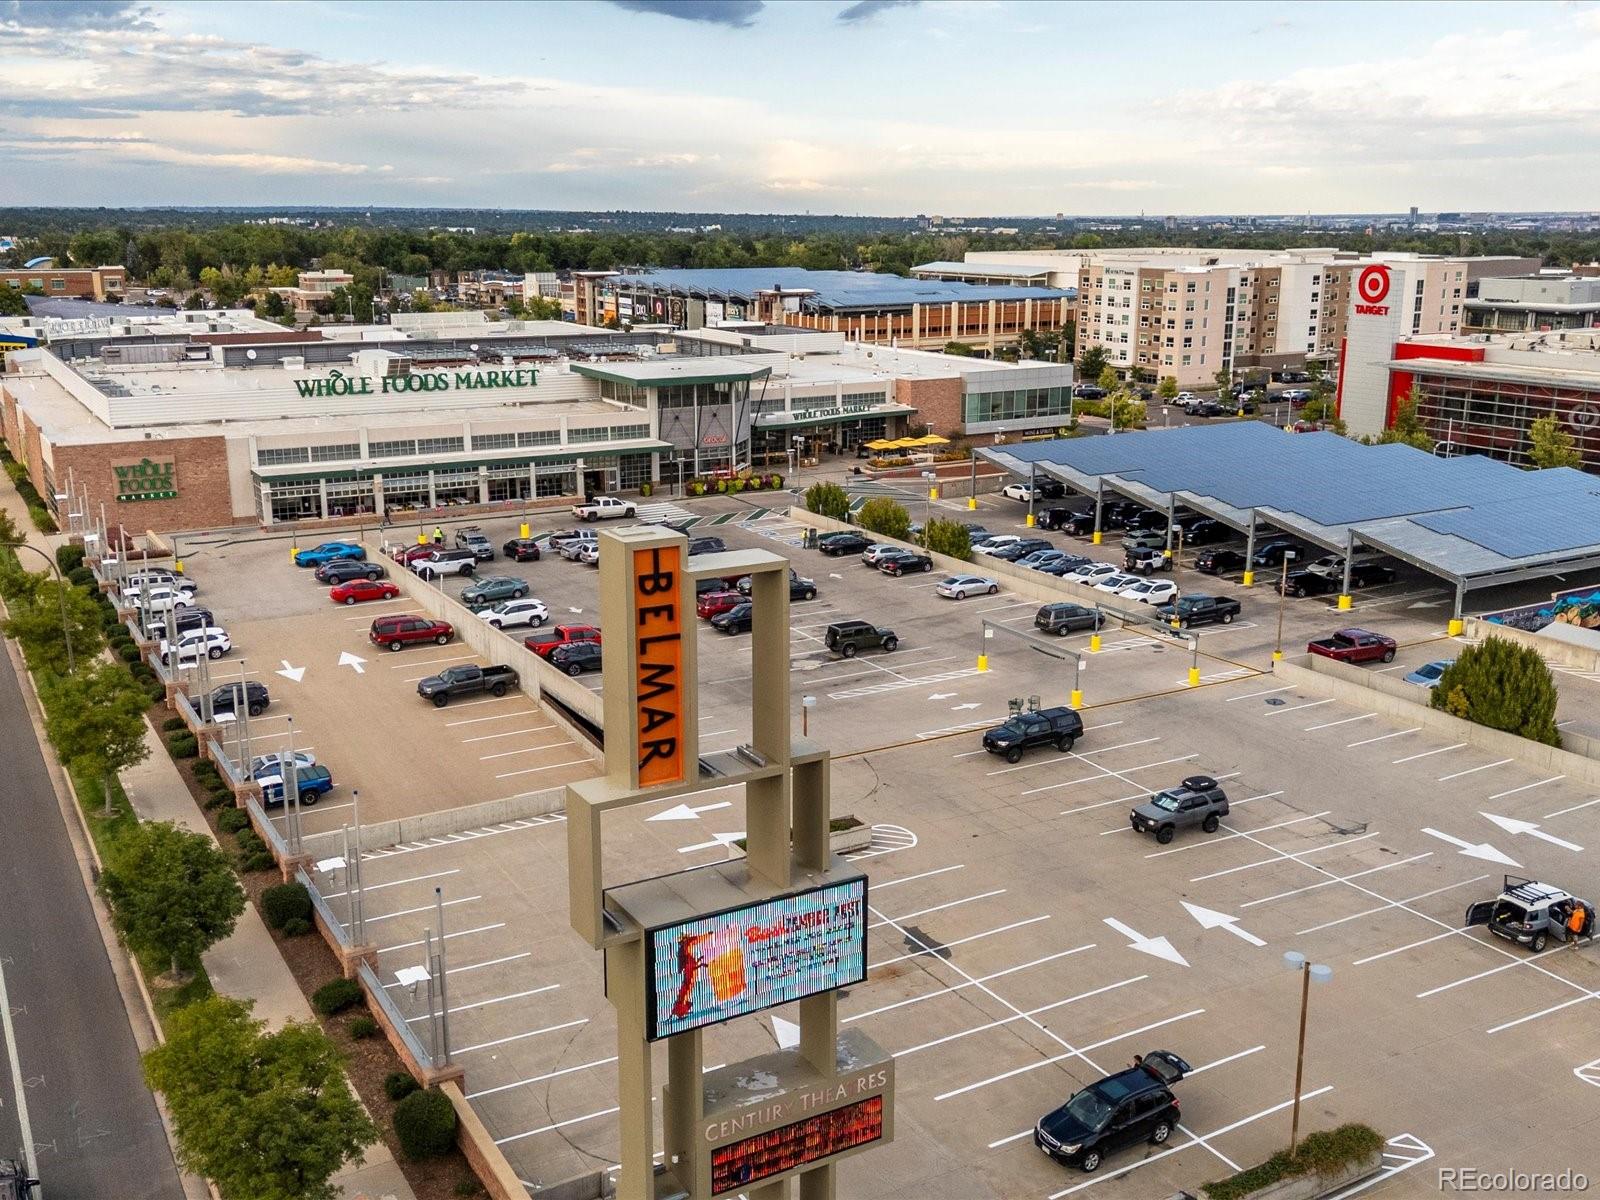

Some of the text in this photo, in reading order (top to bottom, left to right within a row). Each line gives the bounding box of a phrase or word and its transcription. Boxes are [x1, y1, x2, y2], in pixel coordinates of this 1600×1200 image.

[1355, 304, 1390, 316] TARGET
[294, 369, 540, 398] WHOLE FOODS MARKET
[792, 405, 871, 420] WHOLE FOODS MARKET
[112, 458, 175, 478] WHOLE
[119, 477, 172, 492] FOODS
[121, 491, 174, 500] MARKET
[638, 548, 681, 773] BELMAR
[704, 1070, 888, 1142] CENTURY THEARES
